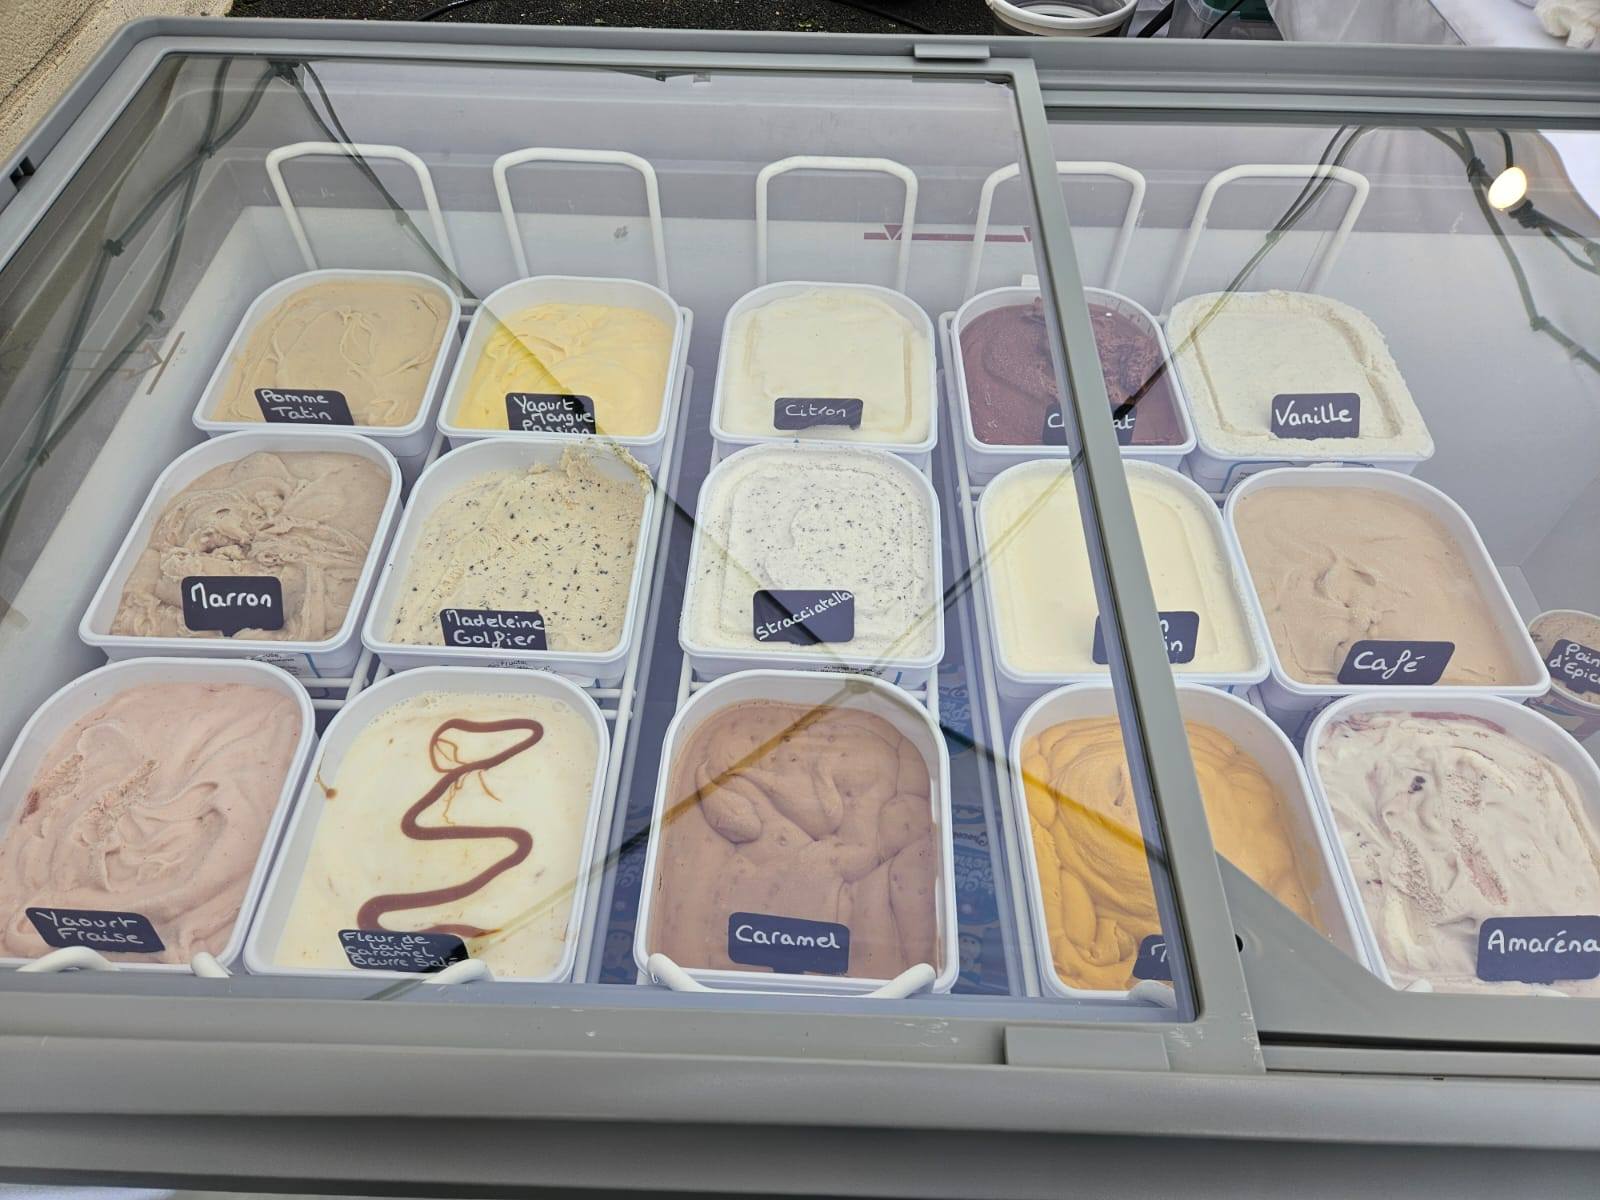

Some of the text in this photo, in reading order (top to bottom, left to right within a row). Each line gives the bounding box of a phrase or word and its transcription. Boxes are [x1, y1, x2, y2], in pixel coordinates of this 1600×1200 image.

[260, 389, 329, 404] Pomme
[513, 395, 574, 414] Yaourt
[270, 406, 332, 421] Tatin
[531, 412, 594, 427] Mangue
[785, 403, 846, 417] Citron
[1275, 400, 1353, 426] Vanille
[190, 582, 272, 609] Marron
[446, 609, 545, 630] Madeleine
[756, 591, 853, 640] Stracciatella
[1353, 649, 1426, 680] Café
[1549, 654, 1600, 685] d'Epic
[35, 911, 138, 928] Yaourt
[57, 927, 144, 944] Fraise
[342, 932, 430, 944] Fleur de
[735, 924, 841, 949] Caramel
[1487, 929, 1600, 955] Amaréna
